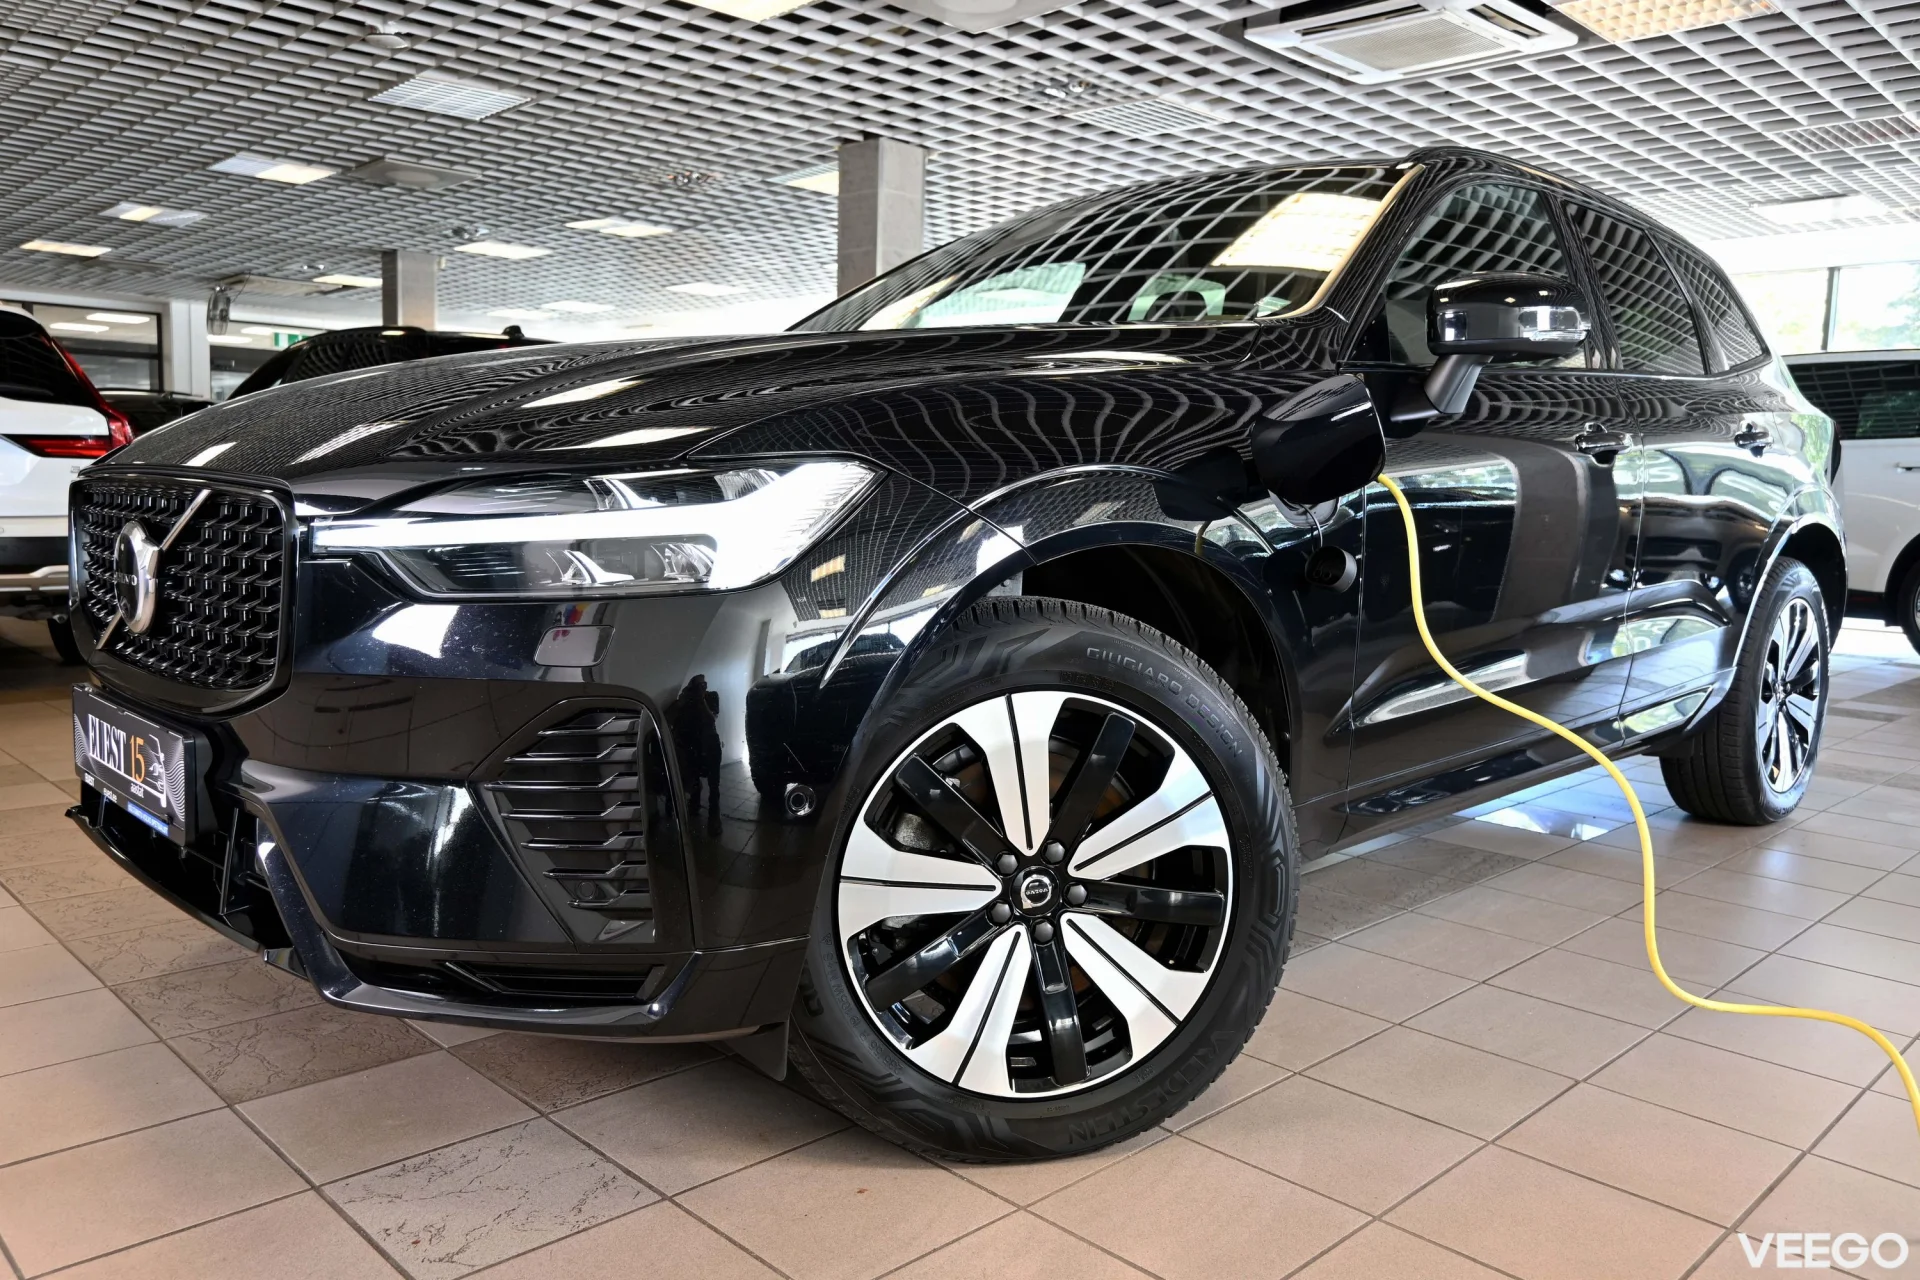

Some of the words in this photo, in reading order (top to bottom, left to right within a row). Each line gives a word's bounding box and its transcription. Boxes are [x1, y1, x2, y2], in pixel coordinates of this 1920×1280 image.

[1086, 647, 1183, 695] GIUGIARO
[1185, 693, 1243, 758] DESIGN
[130, 735, 146, 783] 15
[1025, 887, 1049, 896] VOLVO
